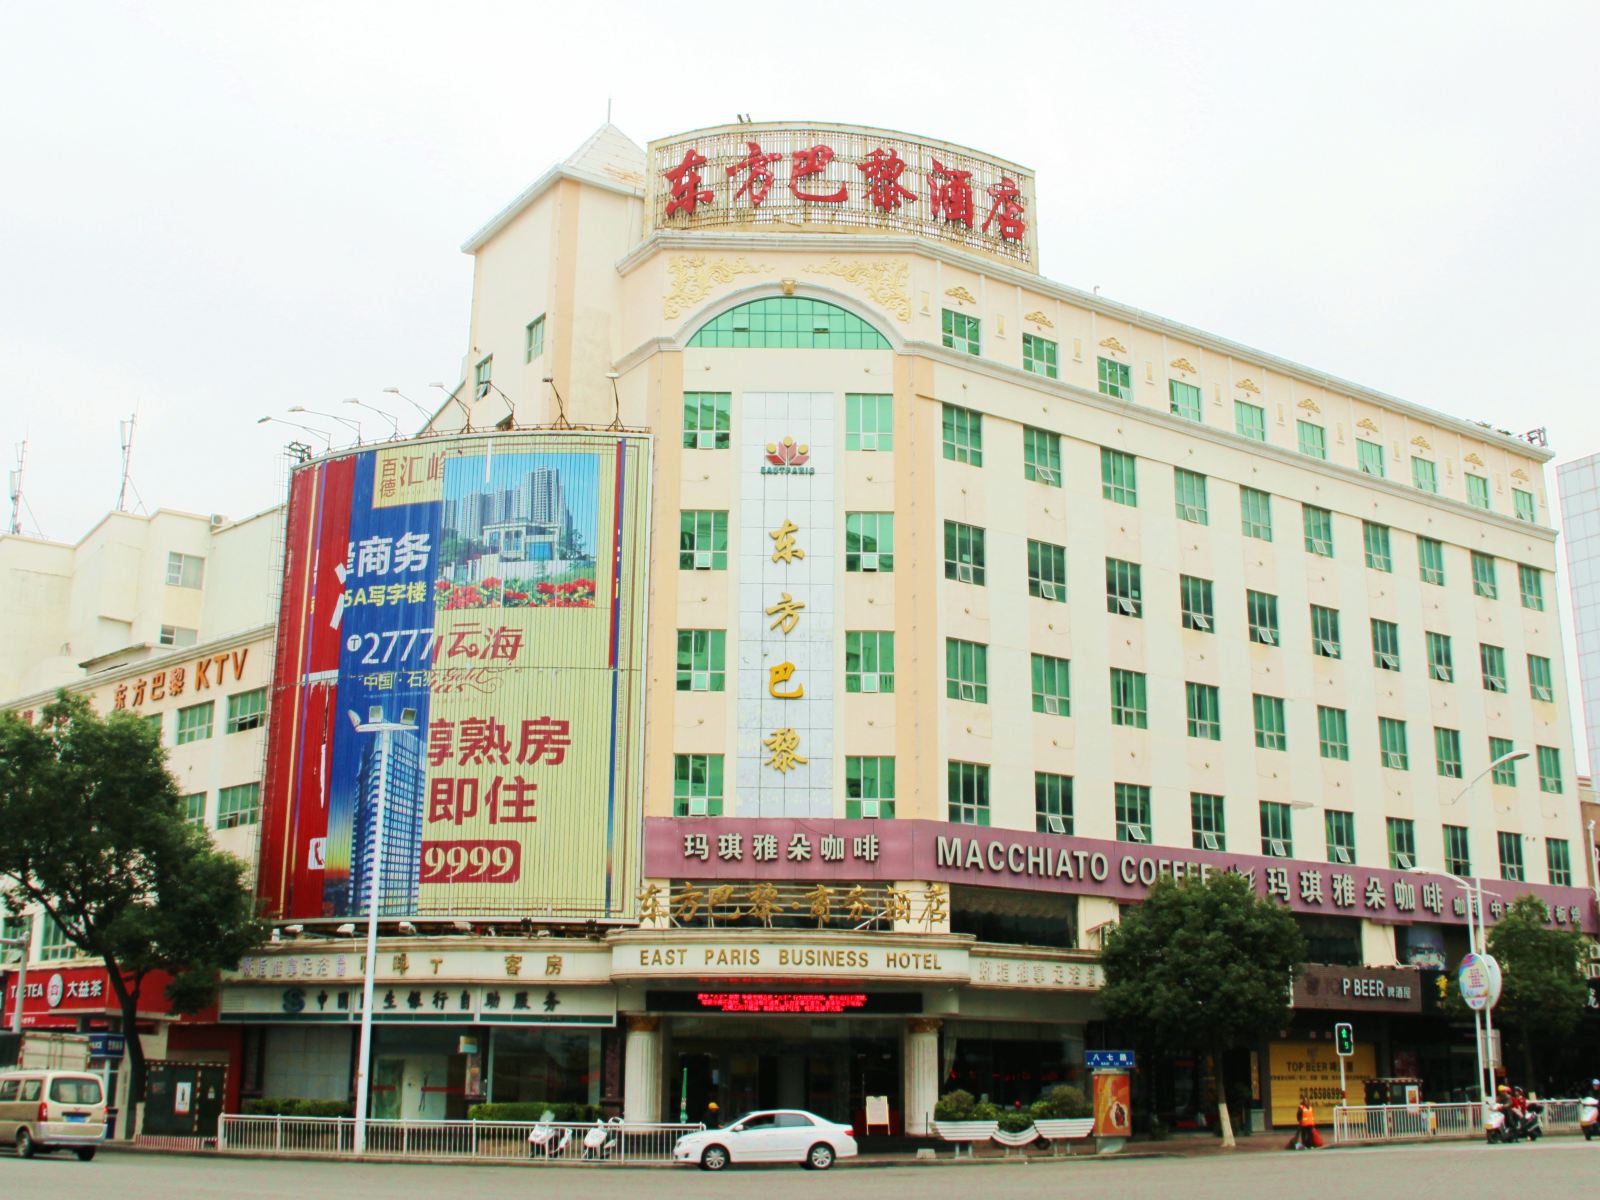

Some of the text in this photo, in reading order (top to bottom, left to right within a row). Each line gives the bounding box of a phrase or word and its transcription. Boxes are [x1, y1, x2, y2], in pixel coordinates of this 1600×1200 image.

[664, 142, 1025, 242] 东方巴黎酒店
[764, 519, 807, 775] 东方巴黎
[113, 649, 249, 710] 东方巴黎 KTV
[427, 776, 538, 825] 即住
[424, 846, 514, 878] 9999
[684, 832, 880, 862] 玛琪雅朵咖啡
[937, 835, 1109, 881] MACCHIATO
[1266, 867, 1443, 914] 玛琪雅朵咖啡
[504, 954, 563, 975] 客房
[640, 948, 942, 970] EAST PARIS BUSINESS HOTEL
[67, 980, 102, 998] 大益茶
[1354, 979, 1384, 997] BEER
